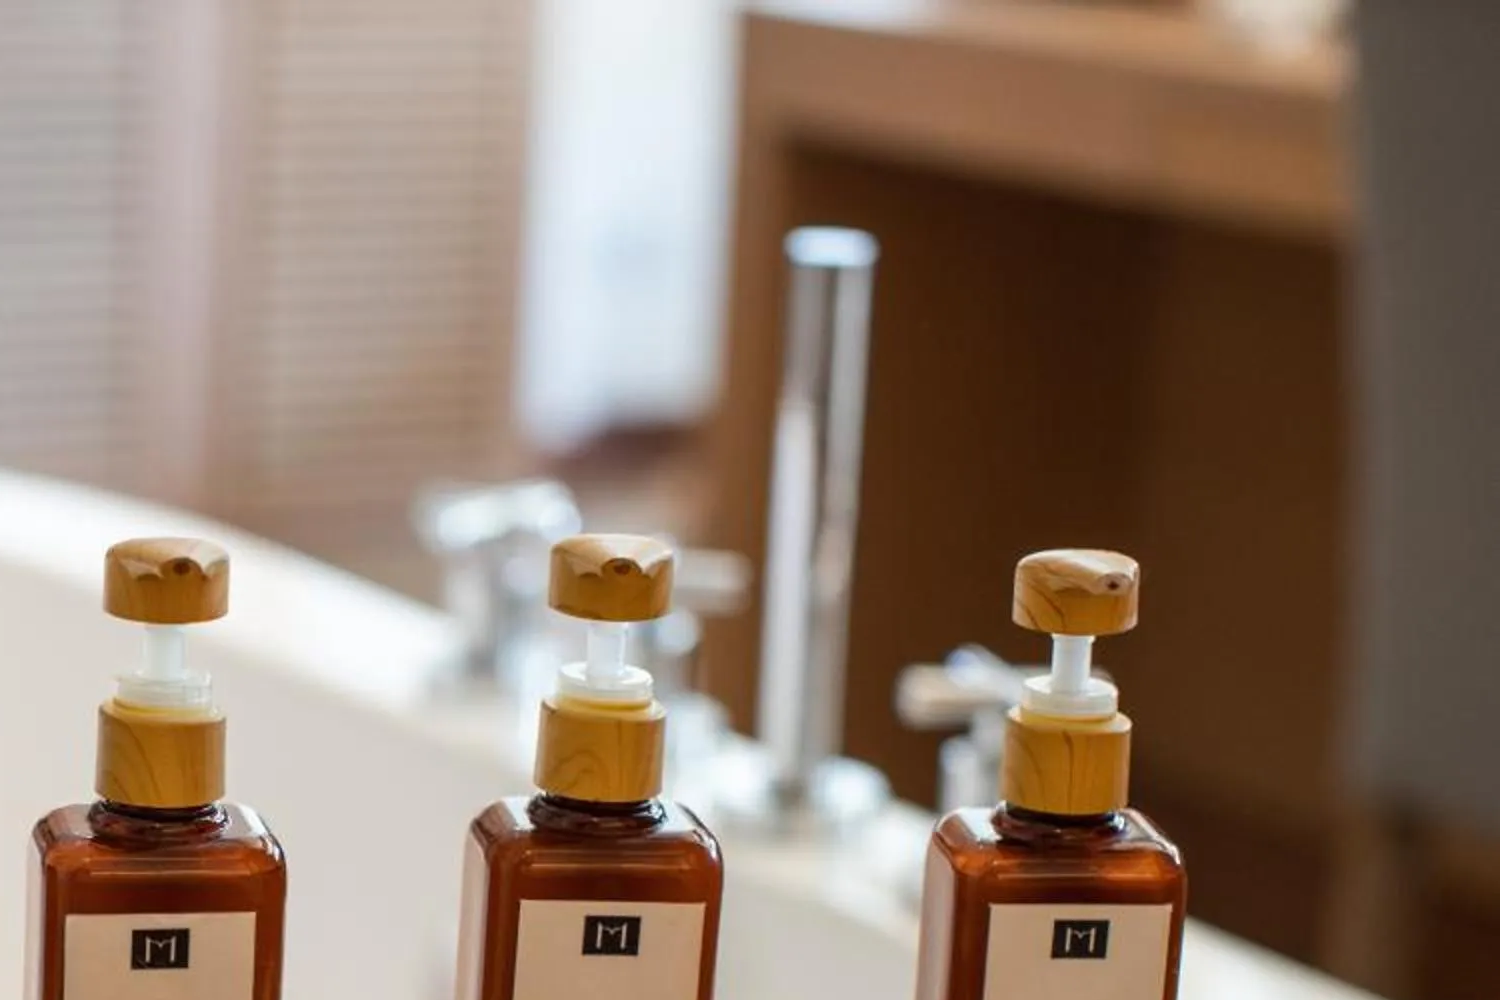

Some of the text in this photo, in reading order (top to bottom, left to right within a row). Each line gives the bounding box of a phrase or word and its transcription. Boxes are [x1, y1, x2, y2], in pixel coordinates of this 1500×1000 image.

[145, 935, 176, 963] M
[596, 922, 628, 949] M
[1065, 927, 1096, 953] M
